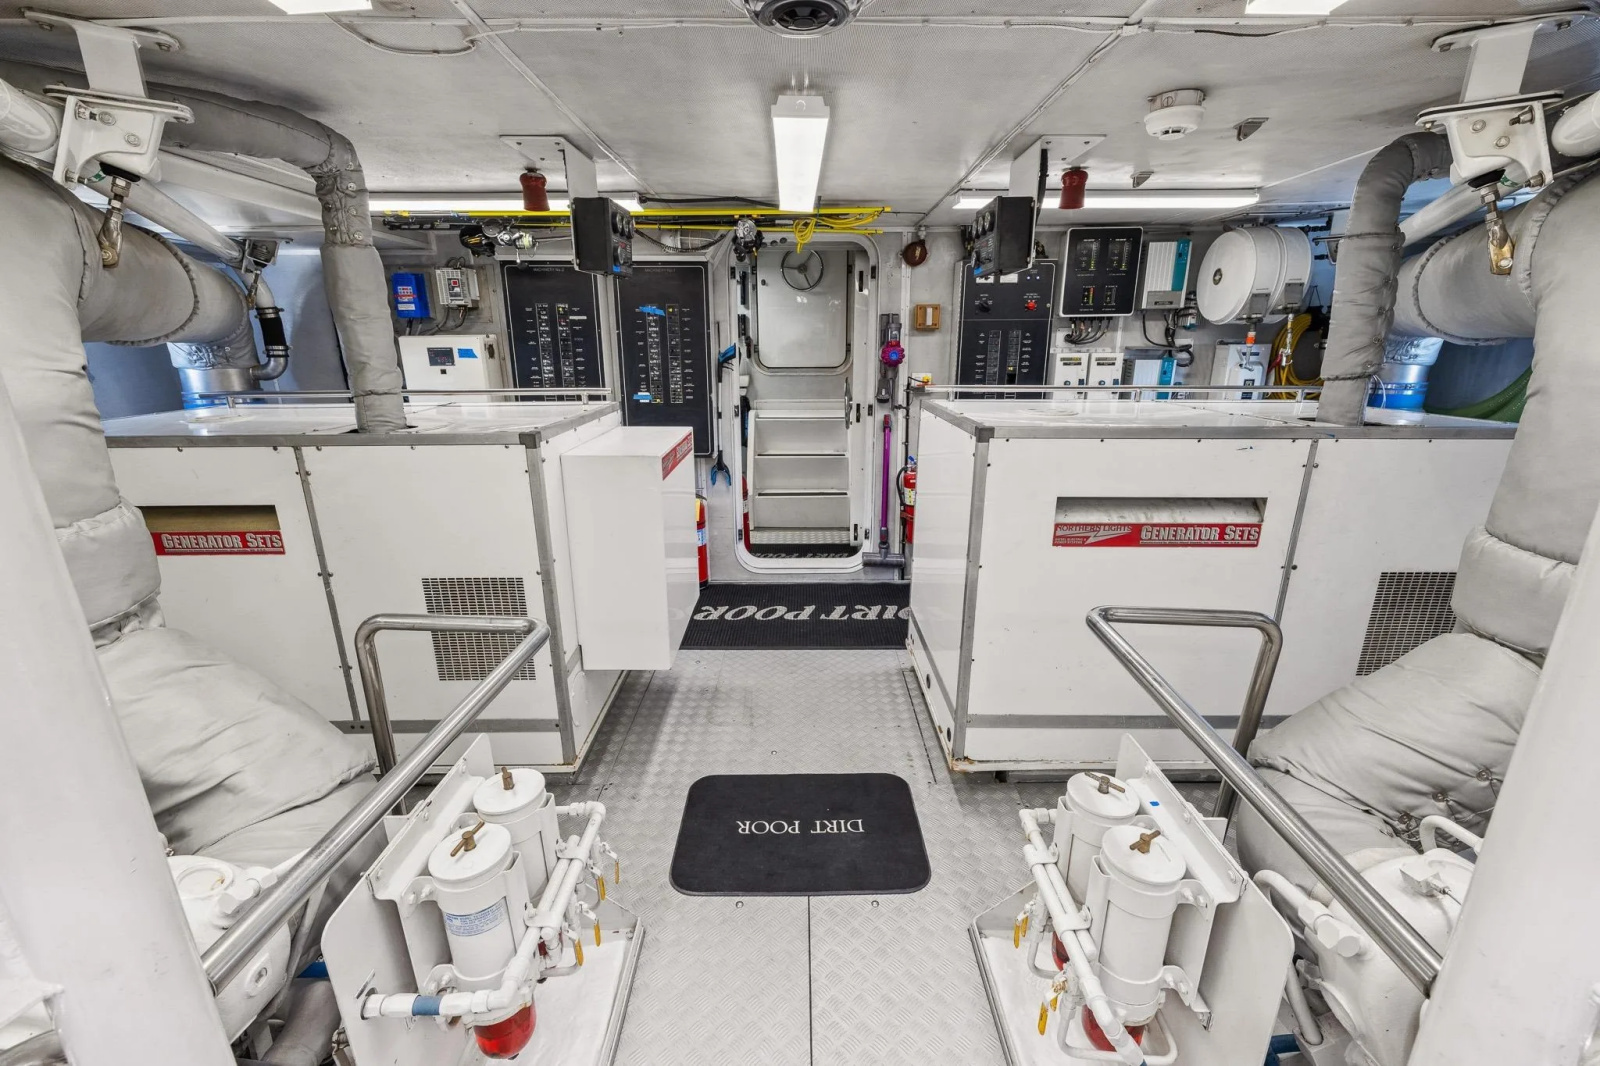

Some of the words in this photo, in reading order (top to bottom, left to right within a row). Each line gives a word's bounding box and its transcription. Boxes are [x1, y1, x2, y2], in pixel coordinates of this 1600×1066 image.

[160, 533, 242, 549] GENERATOR
[245, 532, 282, 548] SETS
[1140, 525, 1220, 541] GENERATOR
[1223, 525, 1260, 541] SETS
[693, 605, 816, 621] POOR
[736, 820, 801, 835] POOR
[810, 819, 865, 834] DIRT
